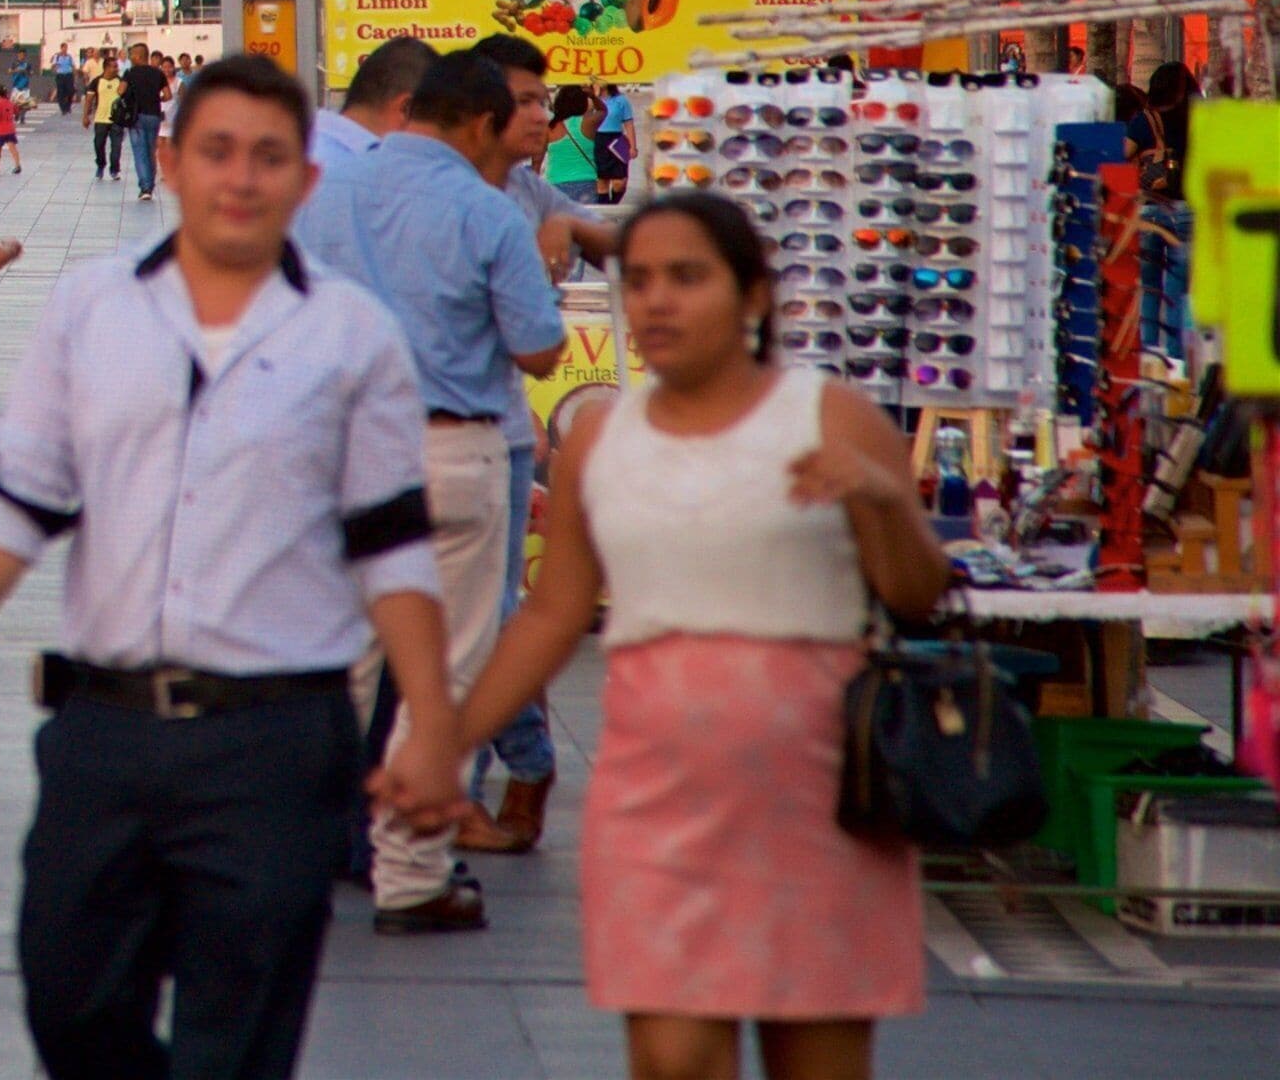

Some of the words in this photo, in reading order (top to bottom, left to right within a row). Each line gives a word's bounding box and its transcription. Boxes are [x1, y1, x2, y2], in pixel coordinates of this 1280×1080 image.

[357, 23, 477, 39] Cacahuate
[566, 35, 625, 46] Naturales
[249, 41, 281, 56] $20
